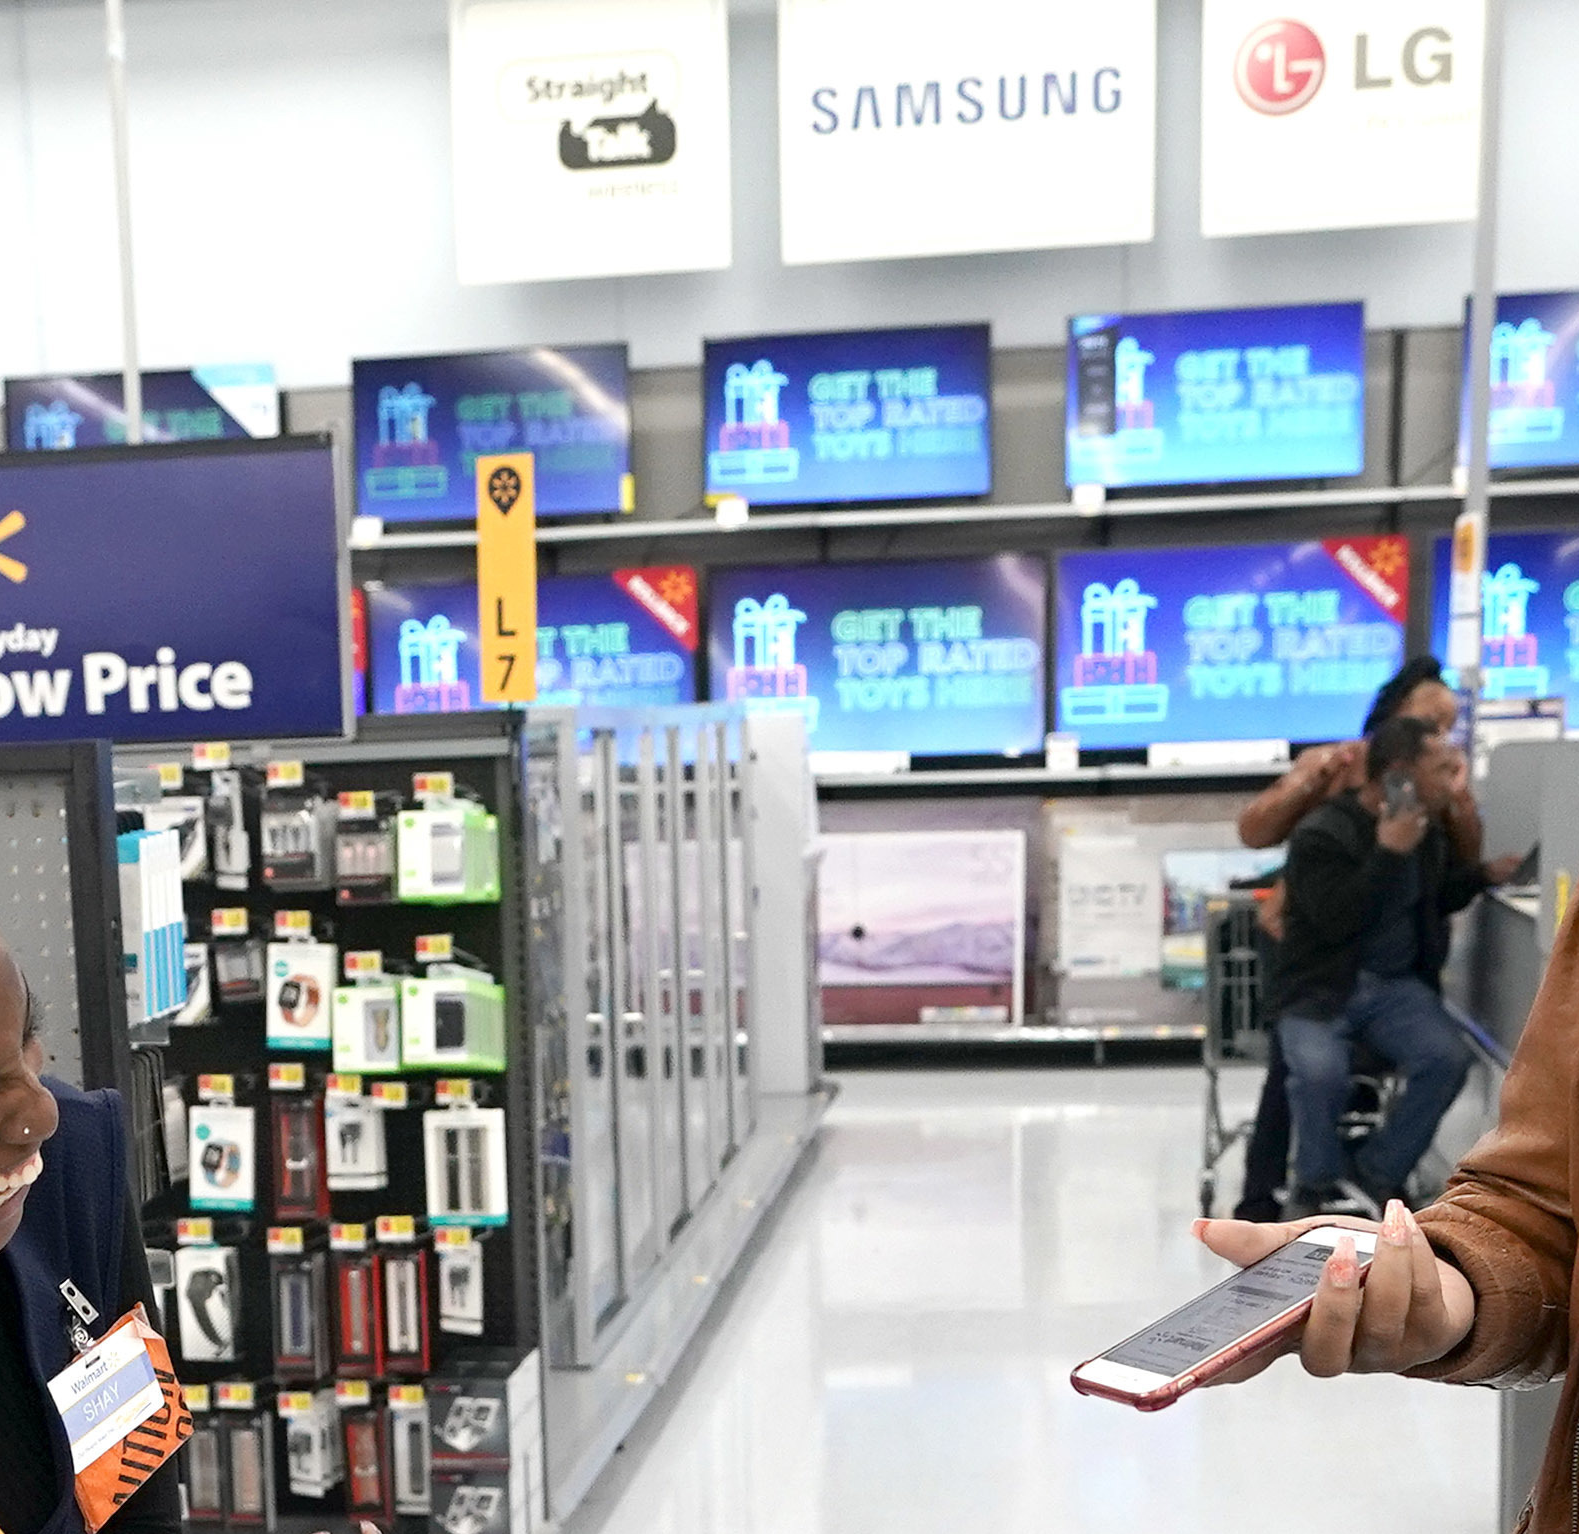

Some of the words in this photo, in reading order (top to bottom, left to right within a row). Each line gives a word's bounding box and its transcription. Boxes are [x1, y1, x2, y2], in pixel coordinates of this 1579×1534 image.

[1353, 27, 1453, 92] LG
[526, 69, 647, 103] Straight
[811, 66, 1121, 135] SAMSUNG
[496, 599, 517, 637] L
[832, 610, 904, 641] GET
[912, 607, 982, 639] THE
[1184, 595, 1254, 628] GET
[1266, 591, 1340, 624] THE
[836, 646, 907, 674] TOP
[918, 640, 1040, 672] RATED
[1186, 630, 1260, 661] TOP
[1275, 624, 1403, 658] RATED
[83, 648, 253, 716] Price
[497, 655, 516, 692] 7
[1188, 664, 1279, 697] TOYS
[837, 677, 925, 708] TOYS
[70, 1361, 108, 1394] Walmart
[82, 1384, 120, 1422] SHAY
